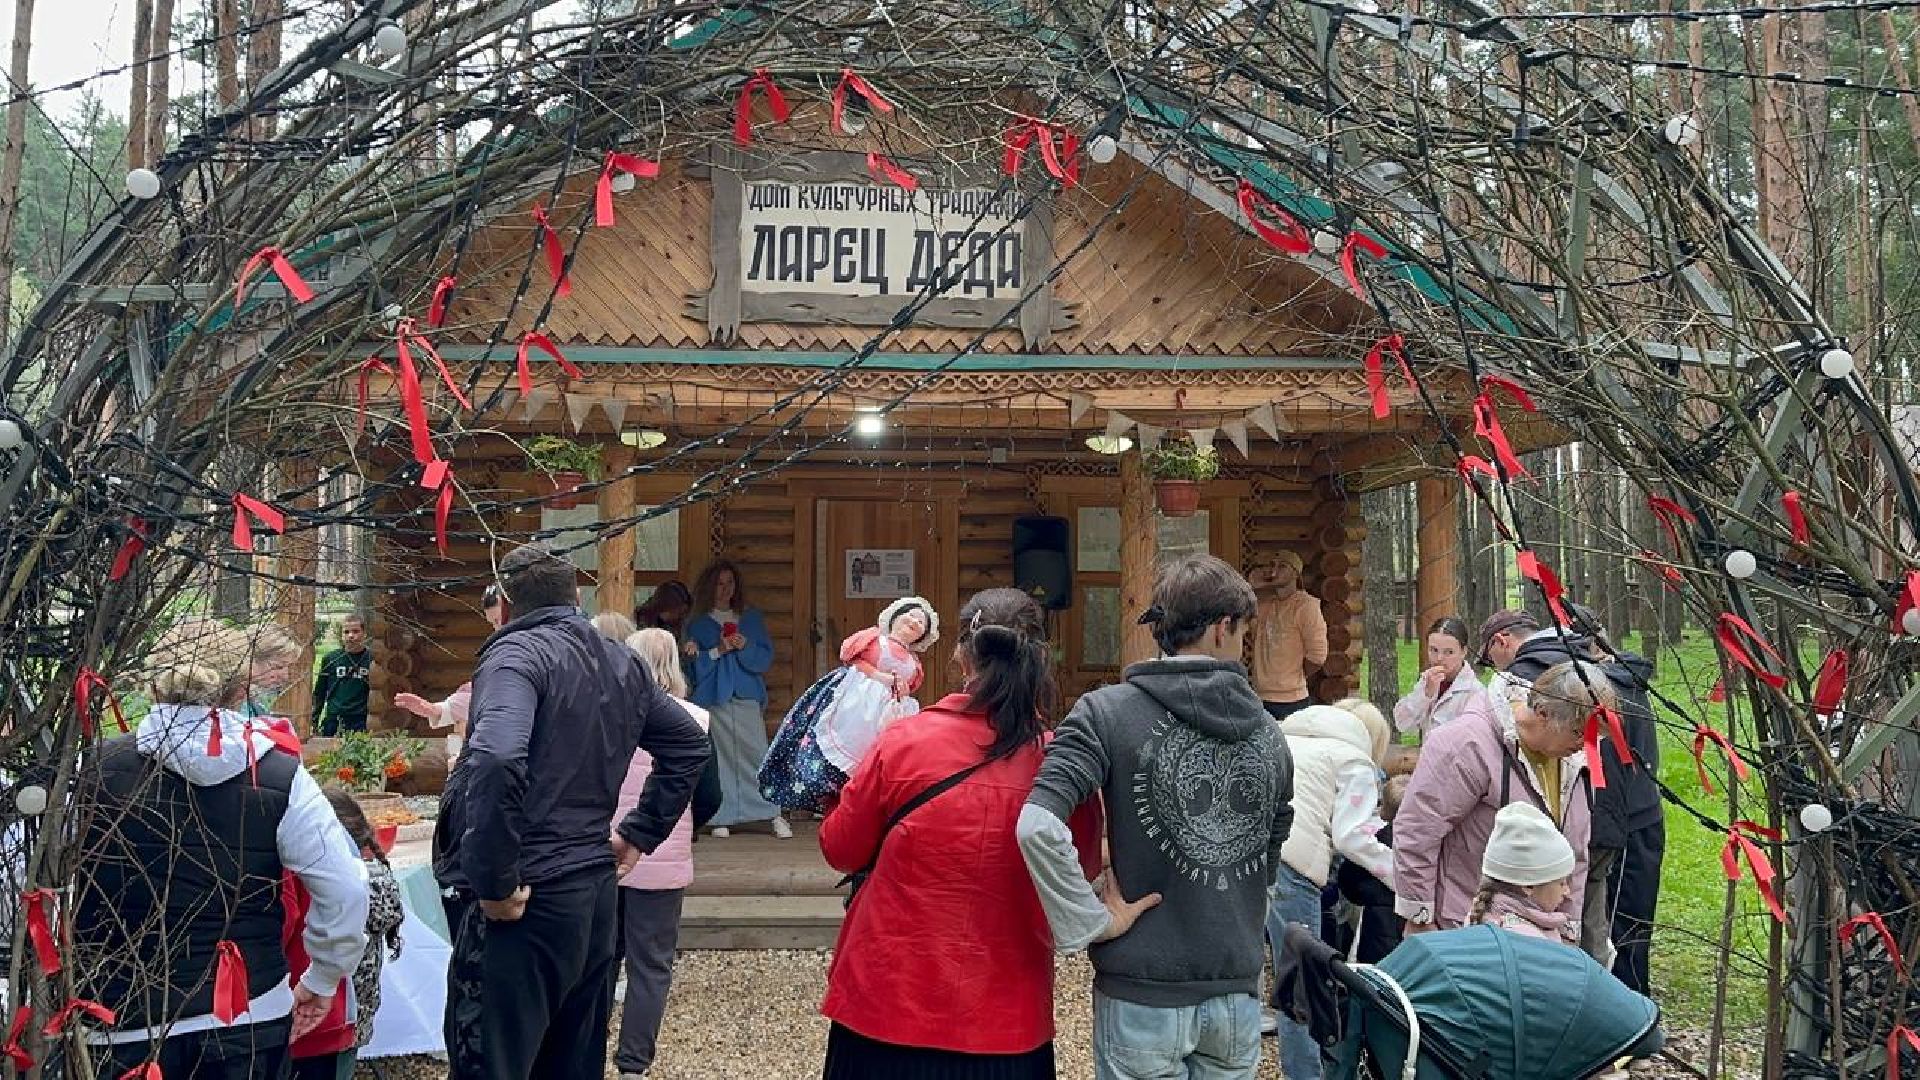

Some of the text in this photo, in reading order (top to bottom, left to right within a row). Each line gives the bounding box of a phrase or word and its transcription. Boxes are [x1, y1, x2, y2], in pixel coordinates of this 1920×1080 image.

[749, 184, 790, 211] ДОМ
[798, 186, 916, 213] КУЛЬТУРНЫХ
[747, 225, 1021, 298] ЛАРЕЦ ДЕДА
